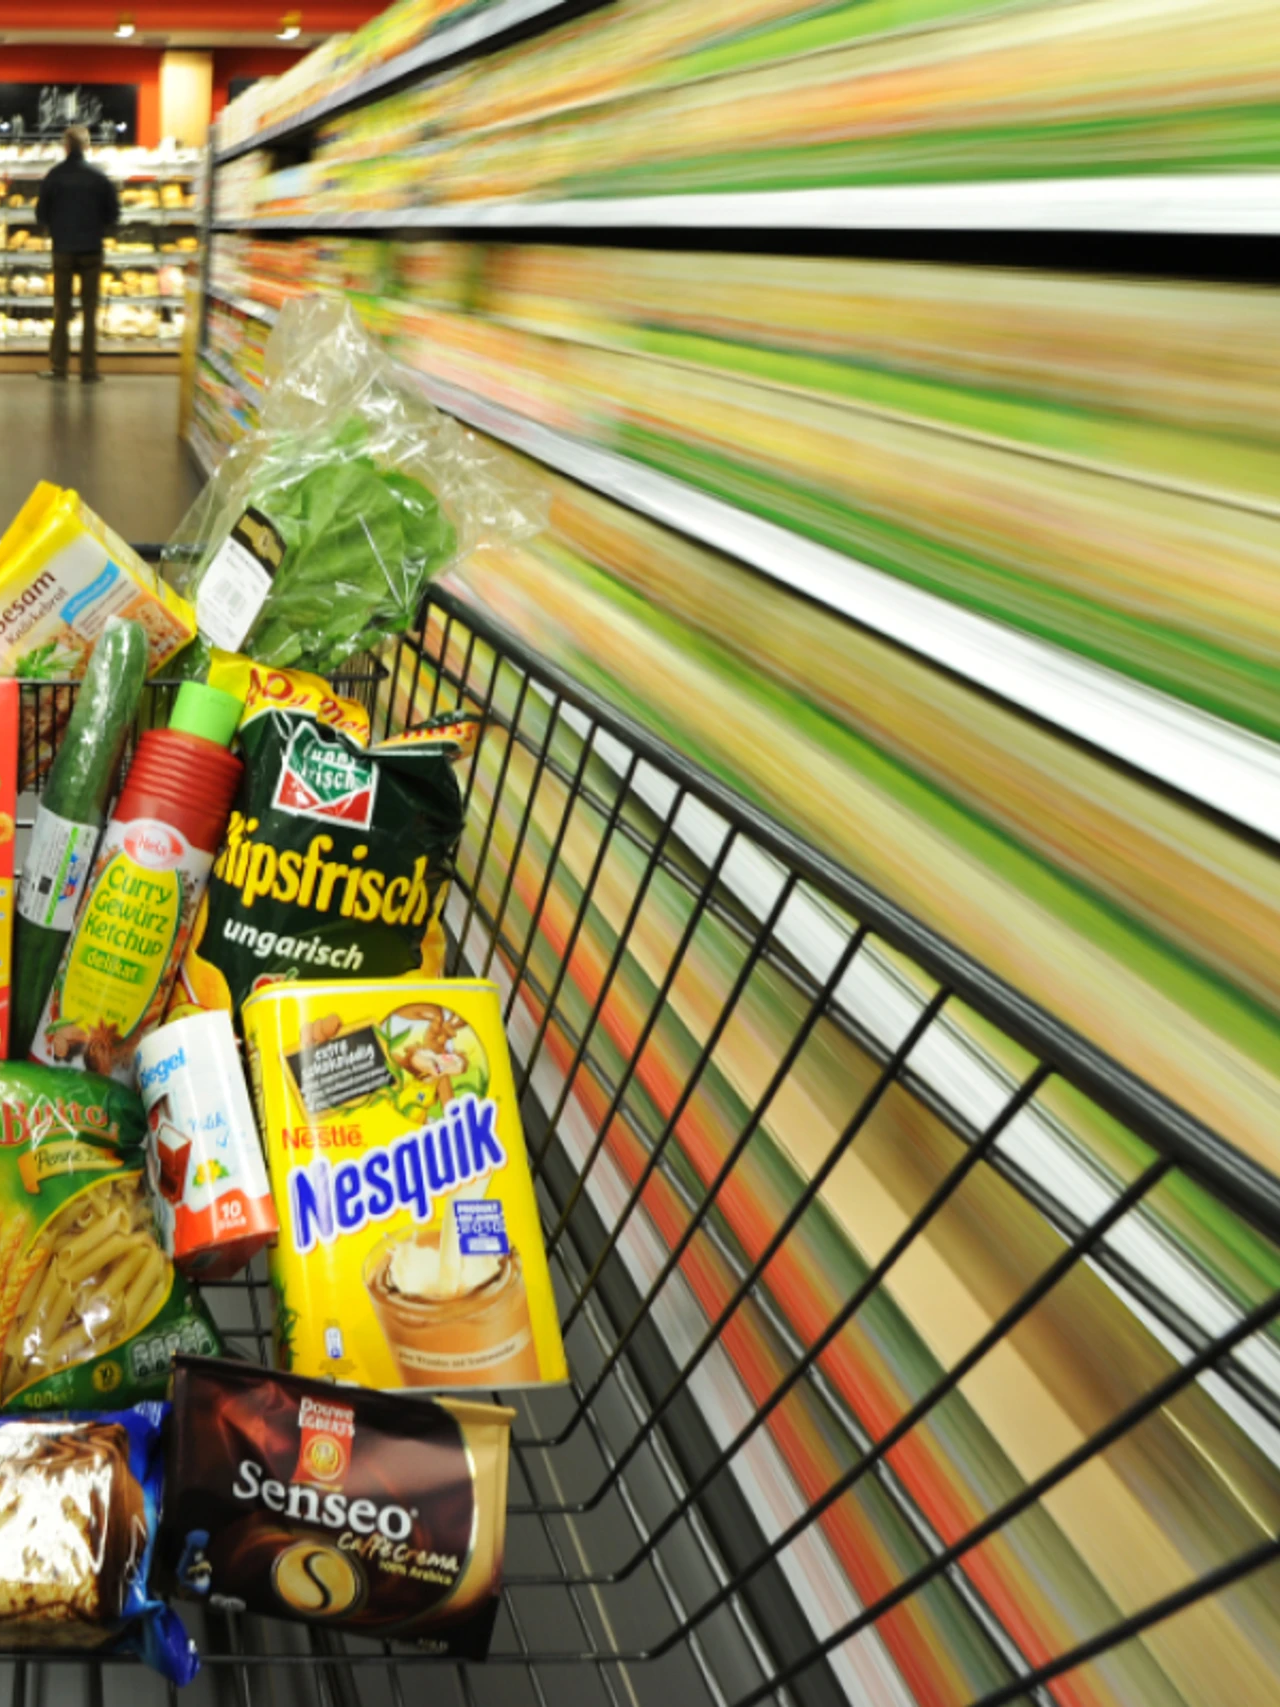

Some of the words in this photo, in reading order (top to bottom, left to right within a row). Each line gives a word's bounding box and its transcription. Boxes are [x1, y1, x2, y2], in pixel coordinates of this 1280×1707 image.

[107, 864, 173, 906] Curry
[93, 890, 169, 934] Gewürz
[84, 912, 164, 958] Ketchup
[222, 918, 364, 971] ungarisch
[87, 949, 139, 980] delikat
[292, 1097, 504, 1249] Nesquik
[221, 1200, 242, 1219] 10
[232, 1460, 413, 1541] Senseo
